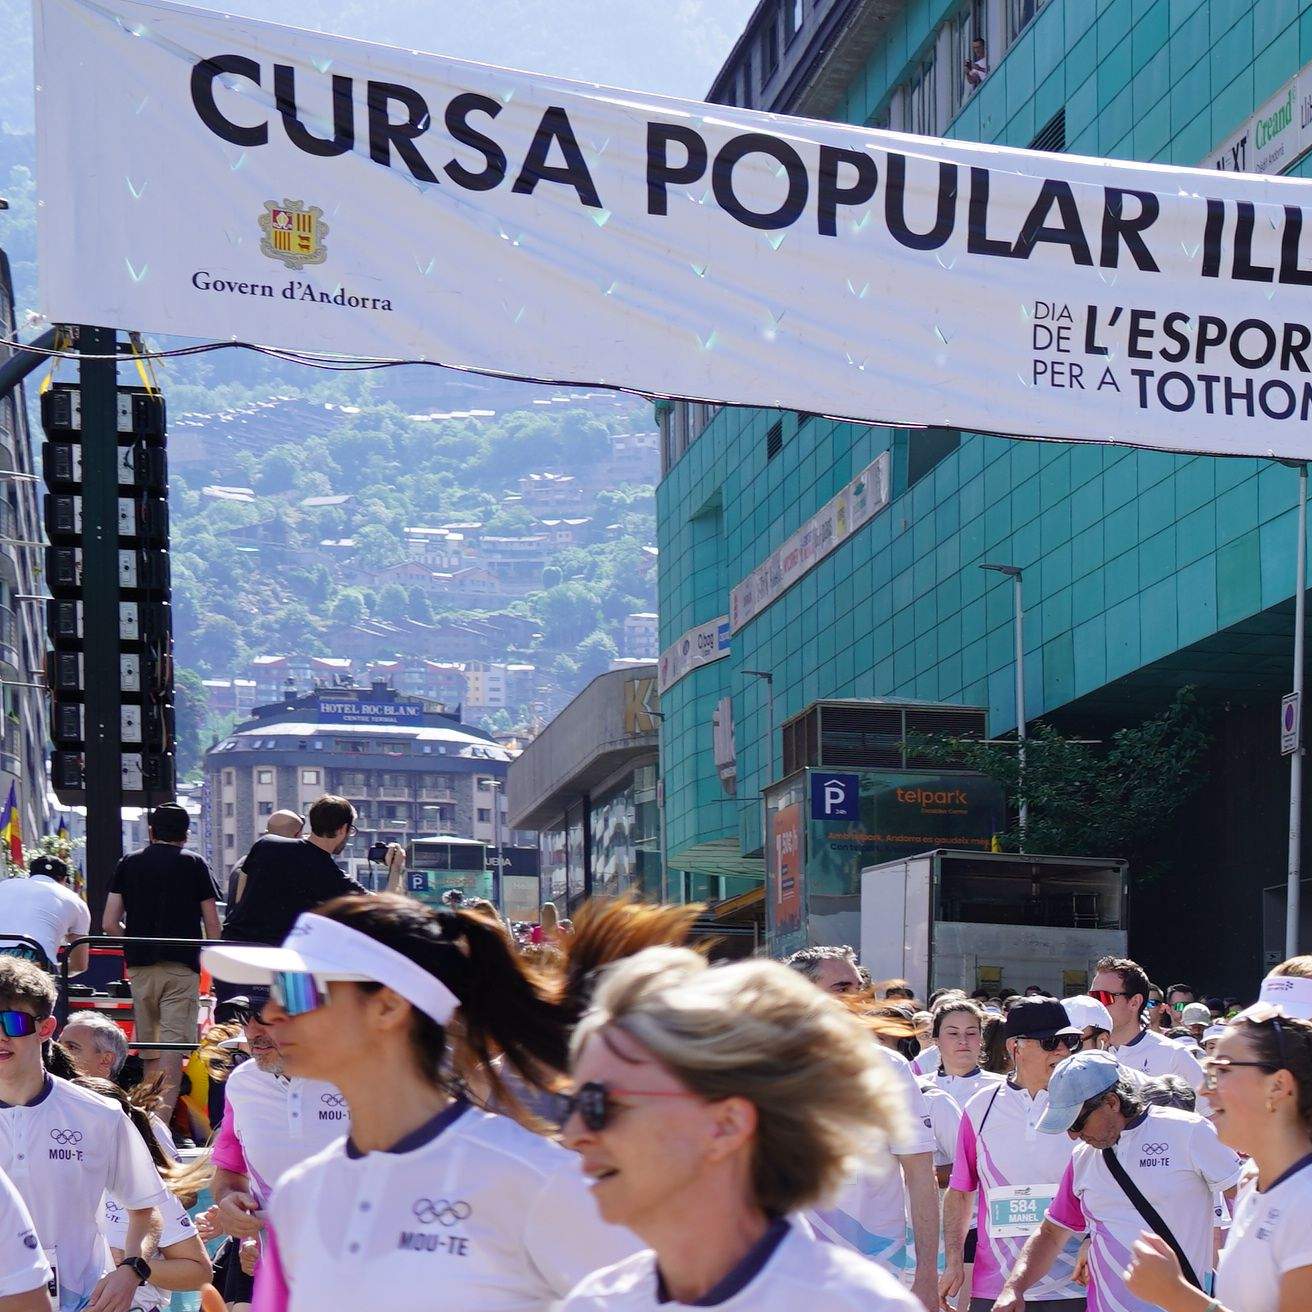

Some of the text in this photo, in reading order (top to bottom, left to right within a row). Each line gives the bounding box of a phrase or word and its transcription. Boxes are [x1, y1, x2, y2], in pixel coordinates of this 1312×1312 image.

[1256, 89, 1292, 150] Creand
[191, 54, 603, 208] CURSA
[646, 122, 1160, 273] POPULAR
[191, 271, 275, 299] Govern
[1034, 300, 1073, 323] DIA
[1033, 323, 1071, 353] DE
[1033, 359, 1085, 390] PER
[1096, 369, 1121, 392] A
[320, 703, 359, 713] HOTEL
[824, 787, 845, 814] P
[896, 788, 968, 806] telpark
[886, 834, 922, 843] Andorra
[1140, 1158, 1170, 1167] MOU-TE
[1009, 1213, 1039, 1223] MANEL
[1010, 1199, 1037, 1213] 584
[398, 1231, 469, 1256] MOU-TE
